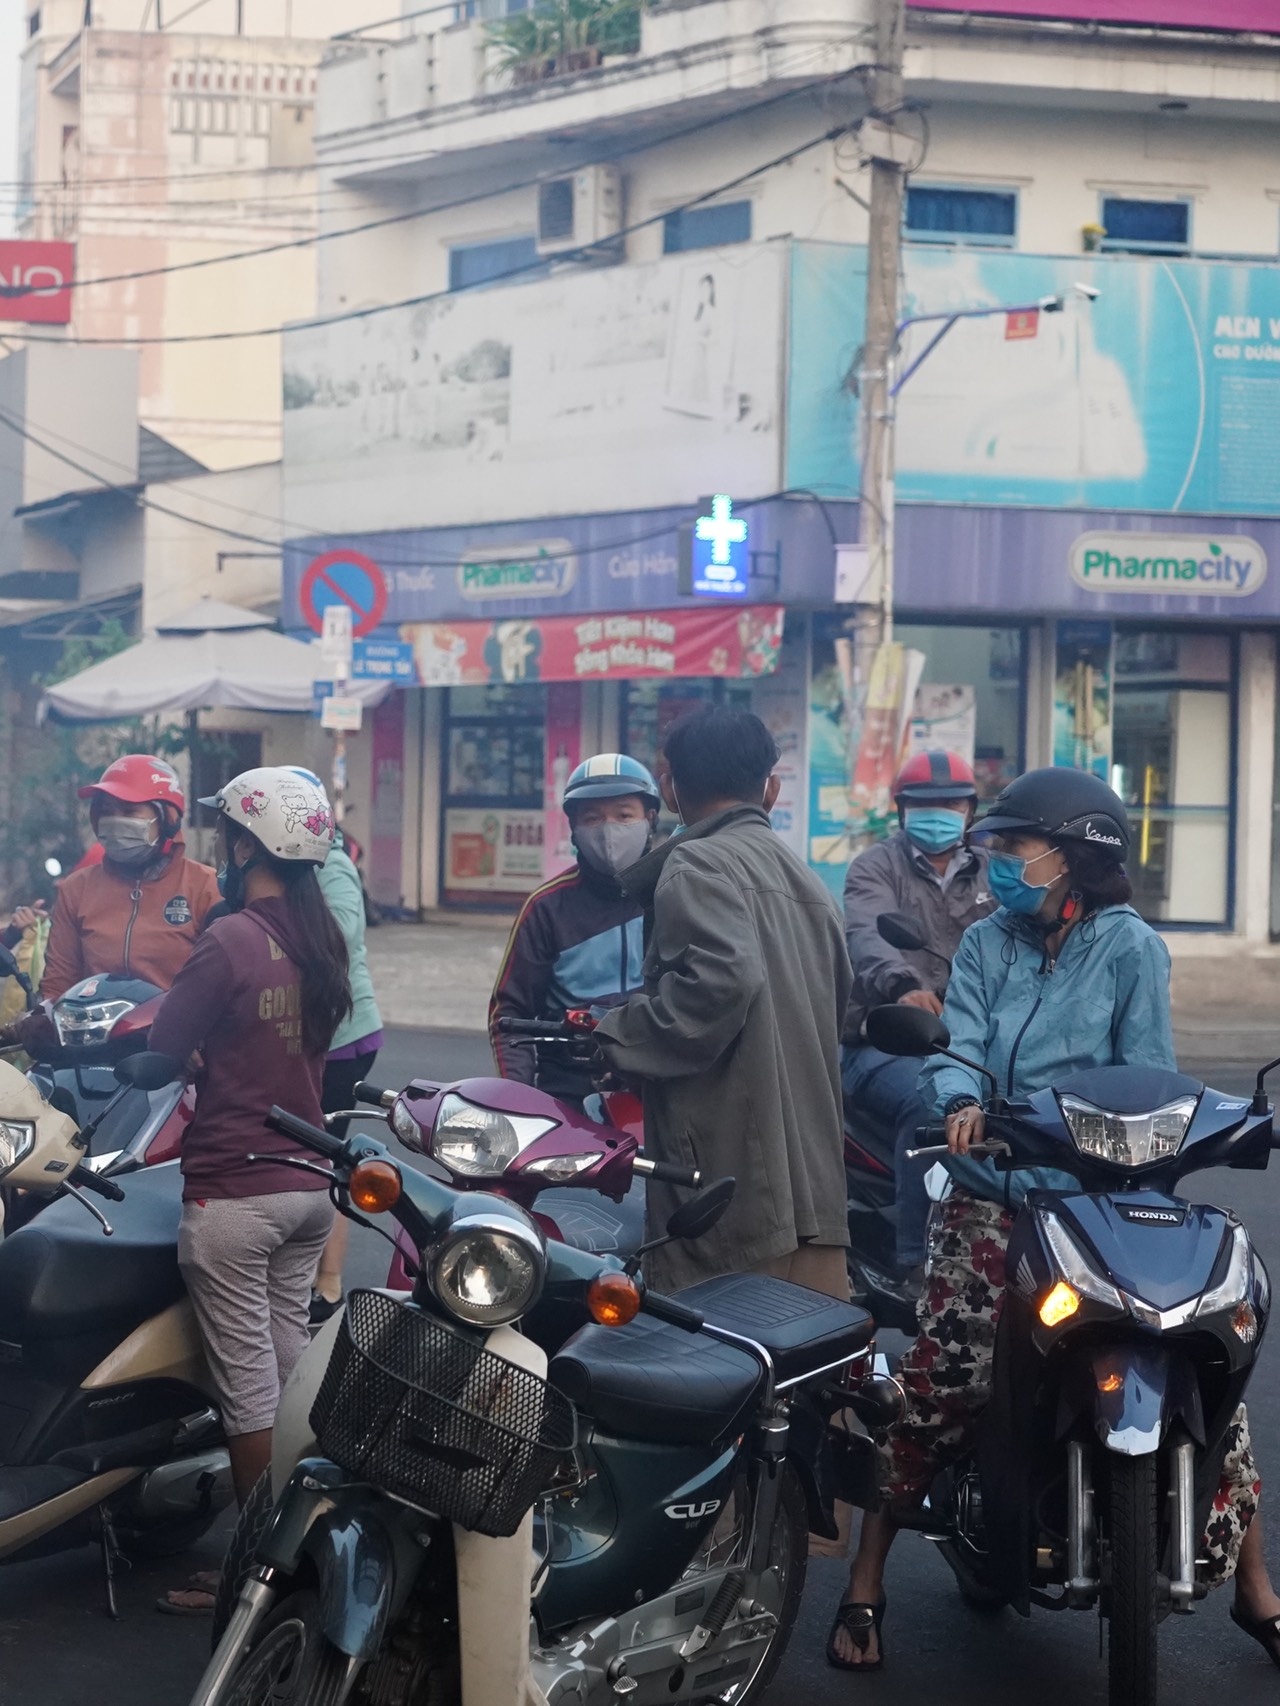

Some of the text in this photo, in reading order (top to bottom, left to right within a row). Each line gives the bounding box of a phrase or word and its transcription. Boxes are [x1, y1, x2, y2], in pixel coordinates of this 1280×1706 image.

[1083, 549, 1252, 590] Pharmacity
[1084, 821, 1123, 847] Vespa
[1128, 1210, 1179, 1222] HONDA
[663, 1499, 721, 1520] CUB
